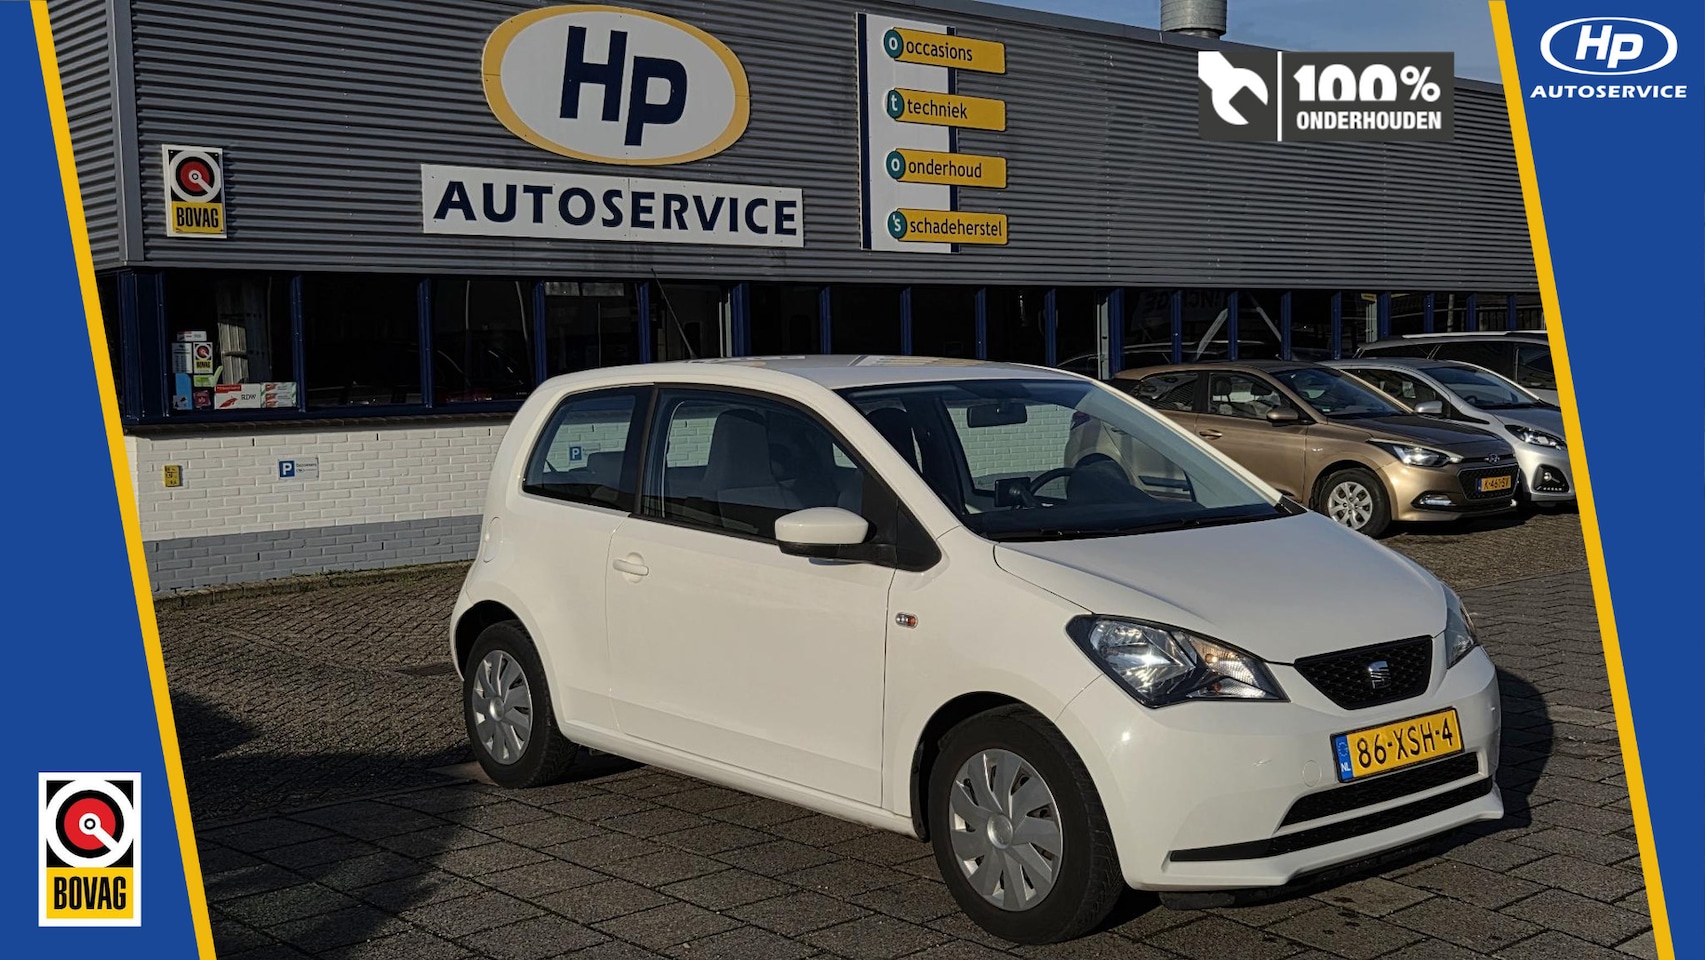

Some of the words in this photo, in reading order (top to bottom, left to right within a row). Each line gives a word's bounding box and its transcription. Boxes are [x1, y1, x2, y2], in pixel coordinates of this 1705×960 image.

[906, 41, 973, 61] occasions
[907, 99, 968, 119] techniek
[908, 158, 982, 178] onderhoud
[176, 207, 219, 228] BOVAG
[433, 181, 798, 236] AUTOSERVICE
[910, 217, 1002, 236] schadeherstel
[282, 462, 292, 475] P
[1356, 717, 1453, 768] 86-XSH-4
[1340, 762, 1351, 772] NL
